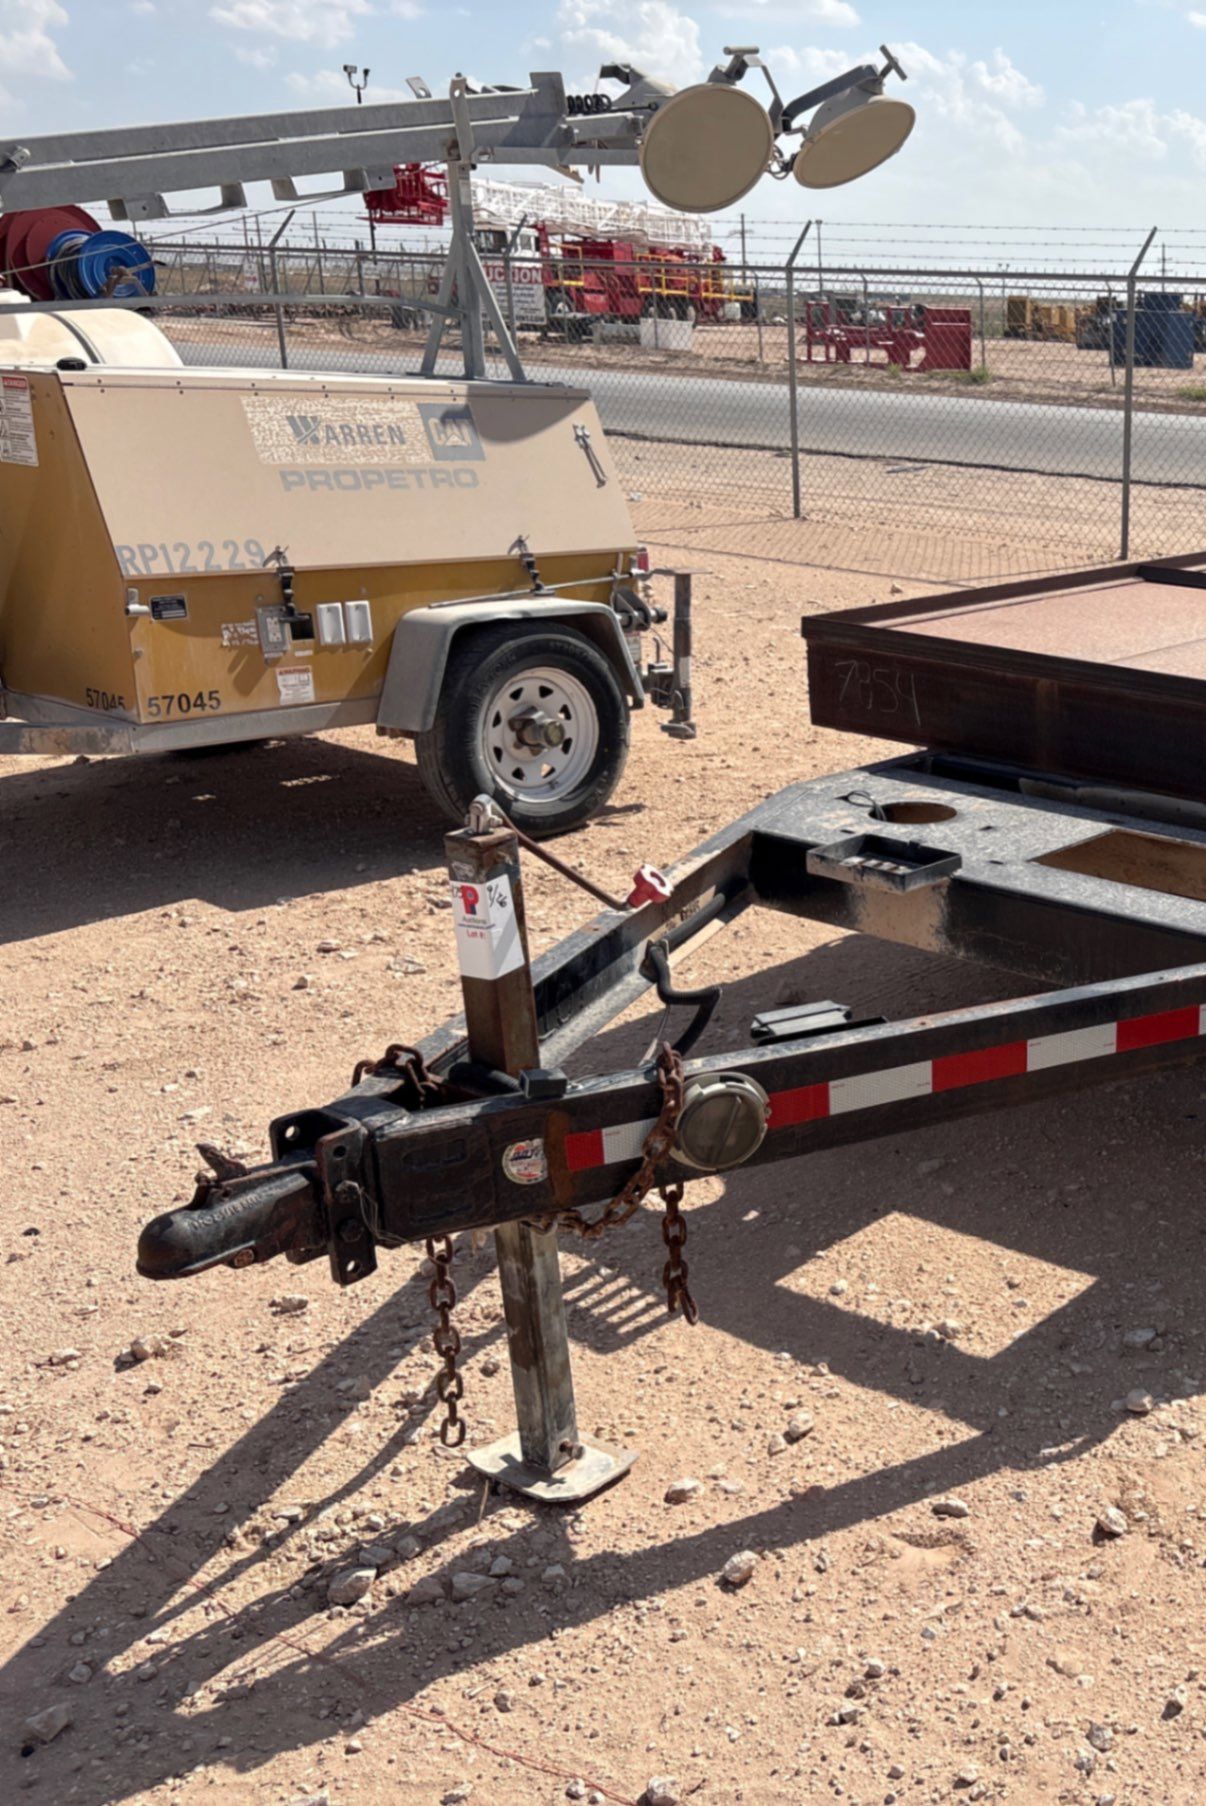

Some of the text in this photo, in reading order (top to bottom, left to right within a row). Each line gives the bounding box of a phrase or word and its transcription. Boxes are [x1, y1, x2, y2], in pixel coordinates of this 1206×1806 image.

[483, 266, 542, 283] UCION
[286, 416, 406, 445] WARREN
[279, 467, 480, 492] PROPETRO
[116, 540, 265, 577] RP12229
[85, 687, 126, 711] 57045
[147, 690, 222, 717] 57045
